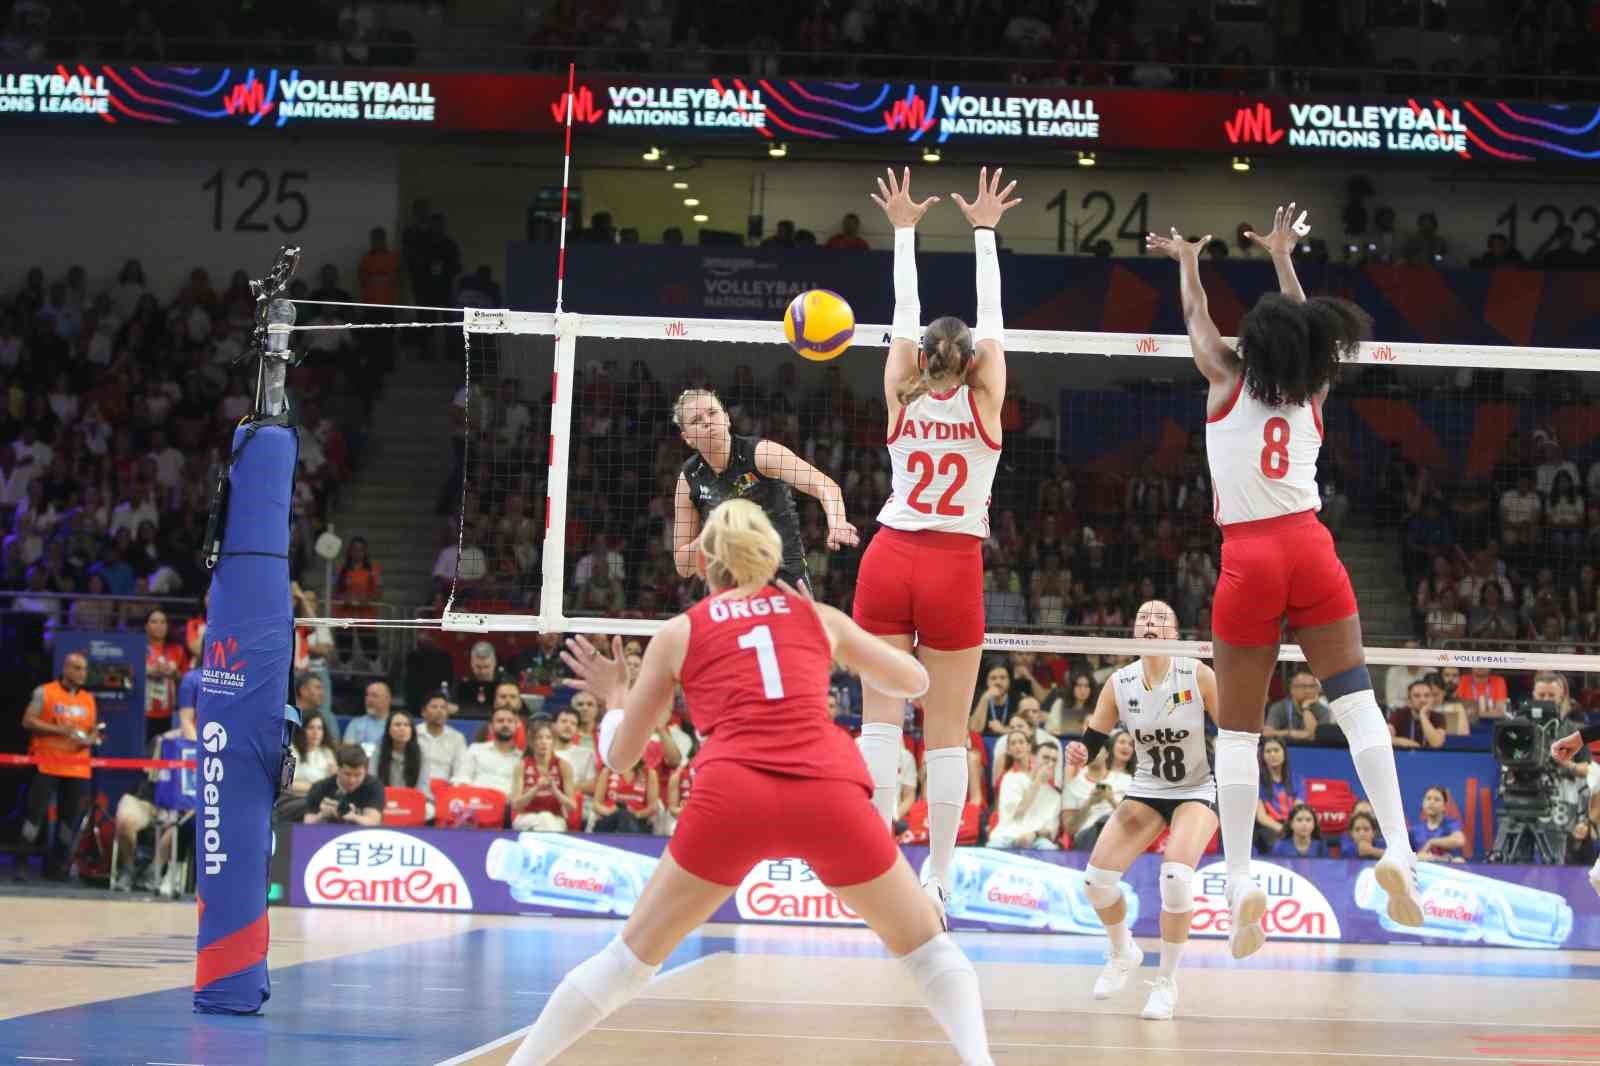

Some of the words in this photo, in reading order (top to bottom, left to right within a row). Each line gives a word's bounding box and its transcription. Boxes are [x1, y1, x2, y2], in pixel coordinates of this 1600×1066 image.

[279, 79, 434, 103] VOLLEYBALL
[608, 86, 765, 110] VOLLEYBALL
[40, 97, 108, 113] LEAGUE
[279, 102, 359, 119] NATIONS
[364, 104, 434, 121] LEAGUE
[608, 108, 689, 126] NATIONS
[694, 110, 765, 127] LEAGUE
[941, 95, 1099, 120] VOLLEYBALL
[1289, 103, 1467, 132] VOLLEYBALL
[941, 118, 1021, 135] NATIONS
[1027, 121, 1098, 137] LEAGUE
[1289, 129, 1380, 148] NATIONS
[1387, 132, 1467, 151] LEAGUE
[203, 168, 308, 233] 125
[1046, 189, 1149, 256] 124
[901, 419, 976, 440] AYDIN
[1261, 416, 1290, 480] 8
[906, 450, 968, 517] 22
[708, 595, 791, 622] ÖRGE
[737, 624, 784, 700] 1
[1135, 728, 1190, 745] lotto
[1146, 745, 1186, 783] 18
[203, 756, 227, 875] Senoh
[336, 842, 426, 867] 百岁山
[1202, 871, 1294, 897] 百山
